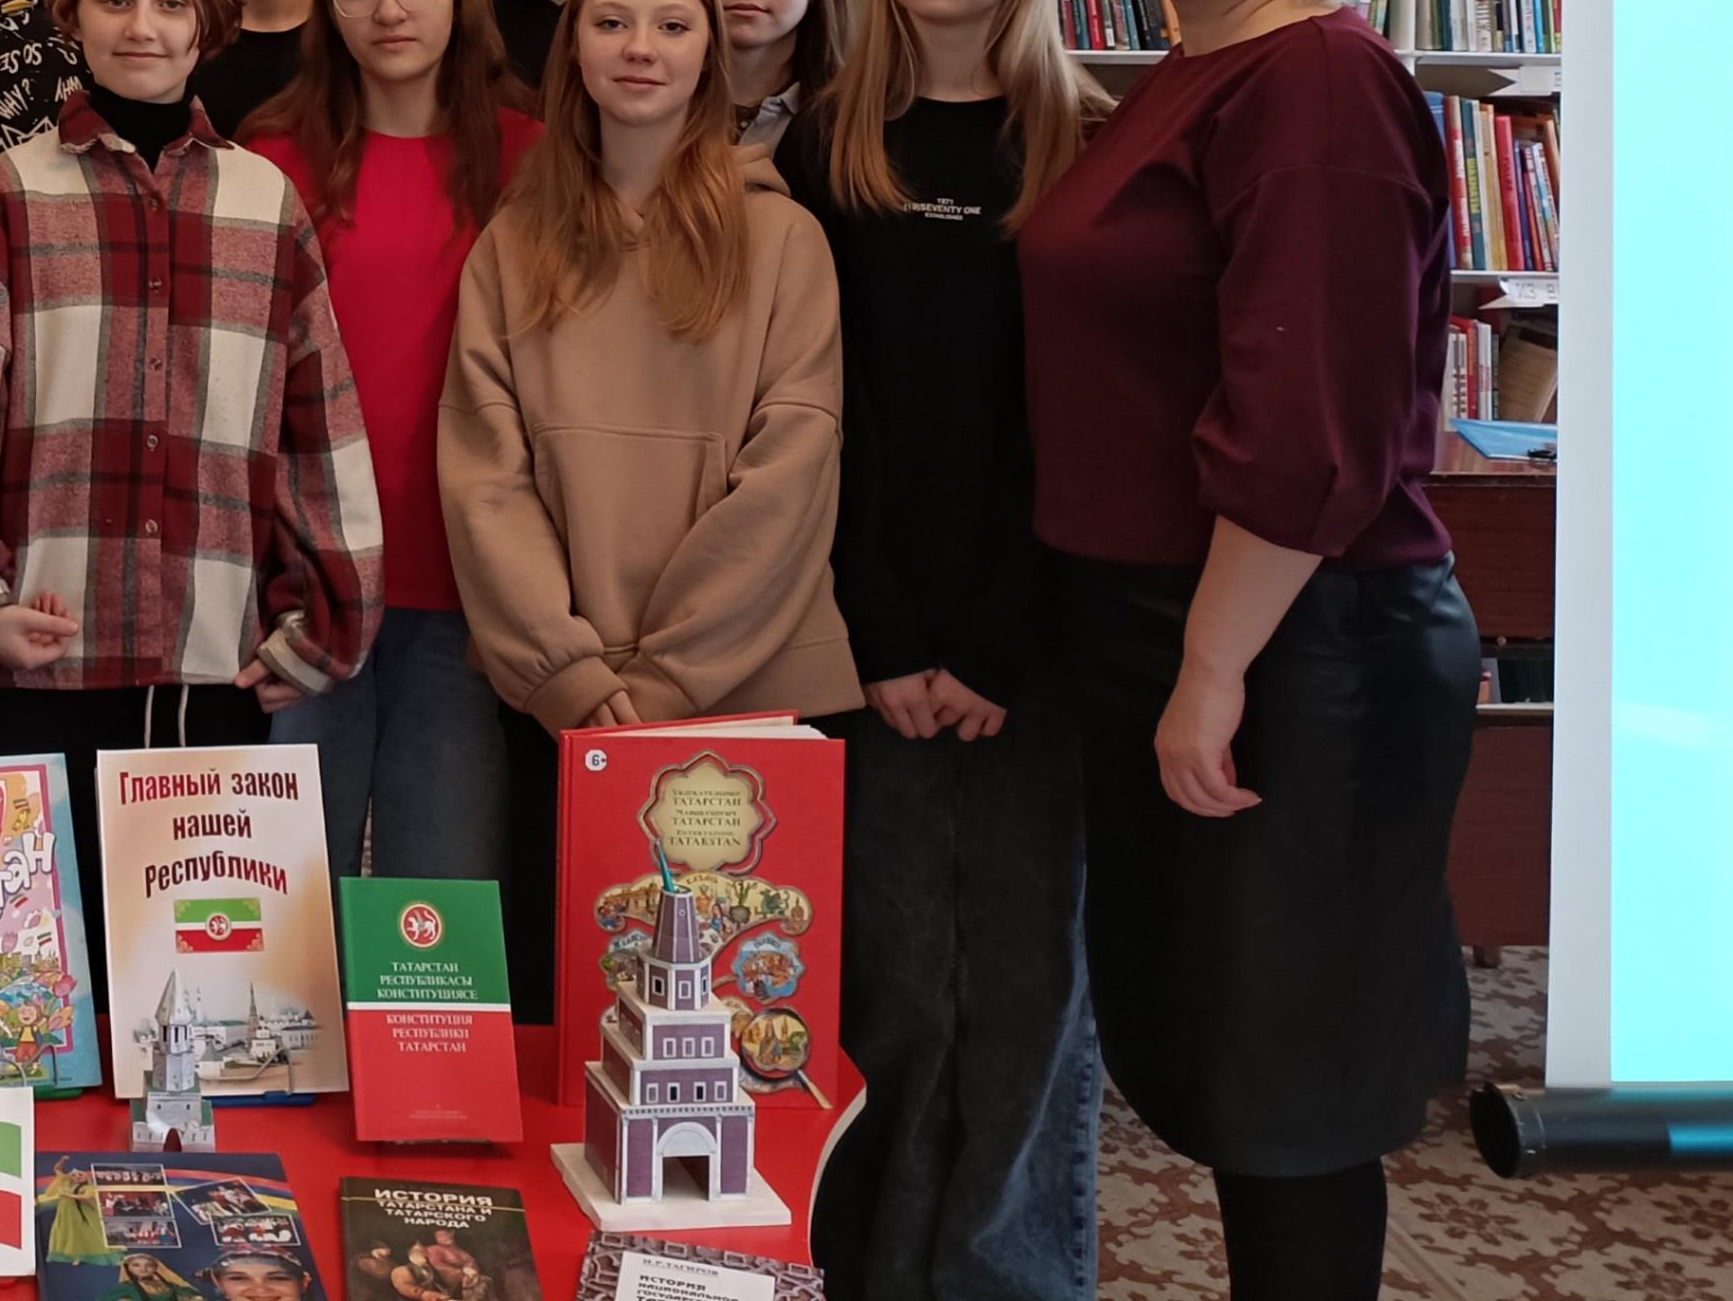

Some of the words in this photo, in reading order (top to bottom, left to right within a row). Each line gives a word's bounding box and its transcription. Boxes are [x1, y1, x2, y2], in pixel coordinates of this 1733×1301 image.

[963, 206, 982, 215] ONE
[119, 767, 221, 805] Главный
[231, 772, 299, 801] закон
[173, 808, 252, 840] нашей
[392, 962, 459, 973] ТАТАРСТАН
[379, 975, 473, 986] РЕСПУБЛИКАСЫ
[377, 988, 478, 1000] КОНСТИТУЦИЯСЕ
[386, 1014, 473, 1025] КОНСТИТУЦИЯ
[392, 1028, 469, 1039] РЕСПУБЛИКИ
[398, 1041, 466, 1052] ТАТАРСТАН
[374, 1188, 493, 1206] ИСТОРИЯ
[378, 1201, 476, 1215] ТАТАРСТАНА
[480, 1208, 492, 1216] И
[386, 1208, 486, 1222] ТАТАРСКОГО
[404, 1217, 470, 1229] НАРОДА
[639, 1275, 706, 1292] ИСТОРИЯ
